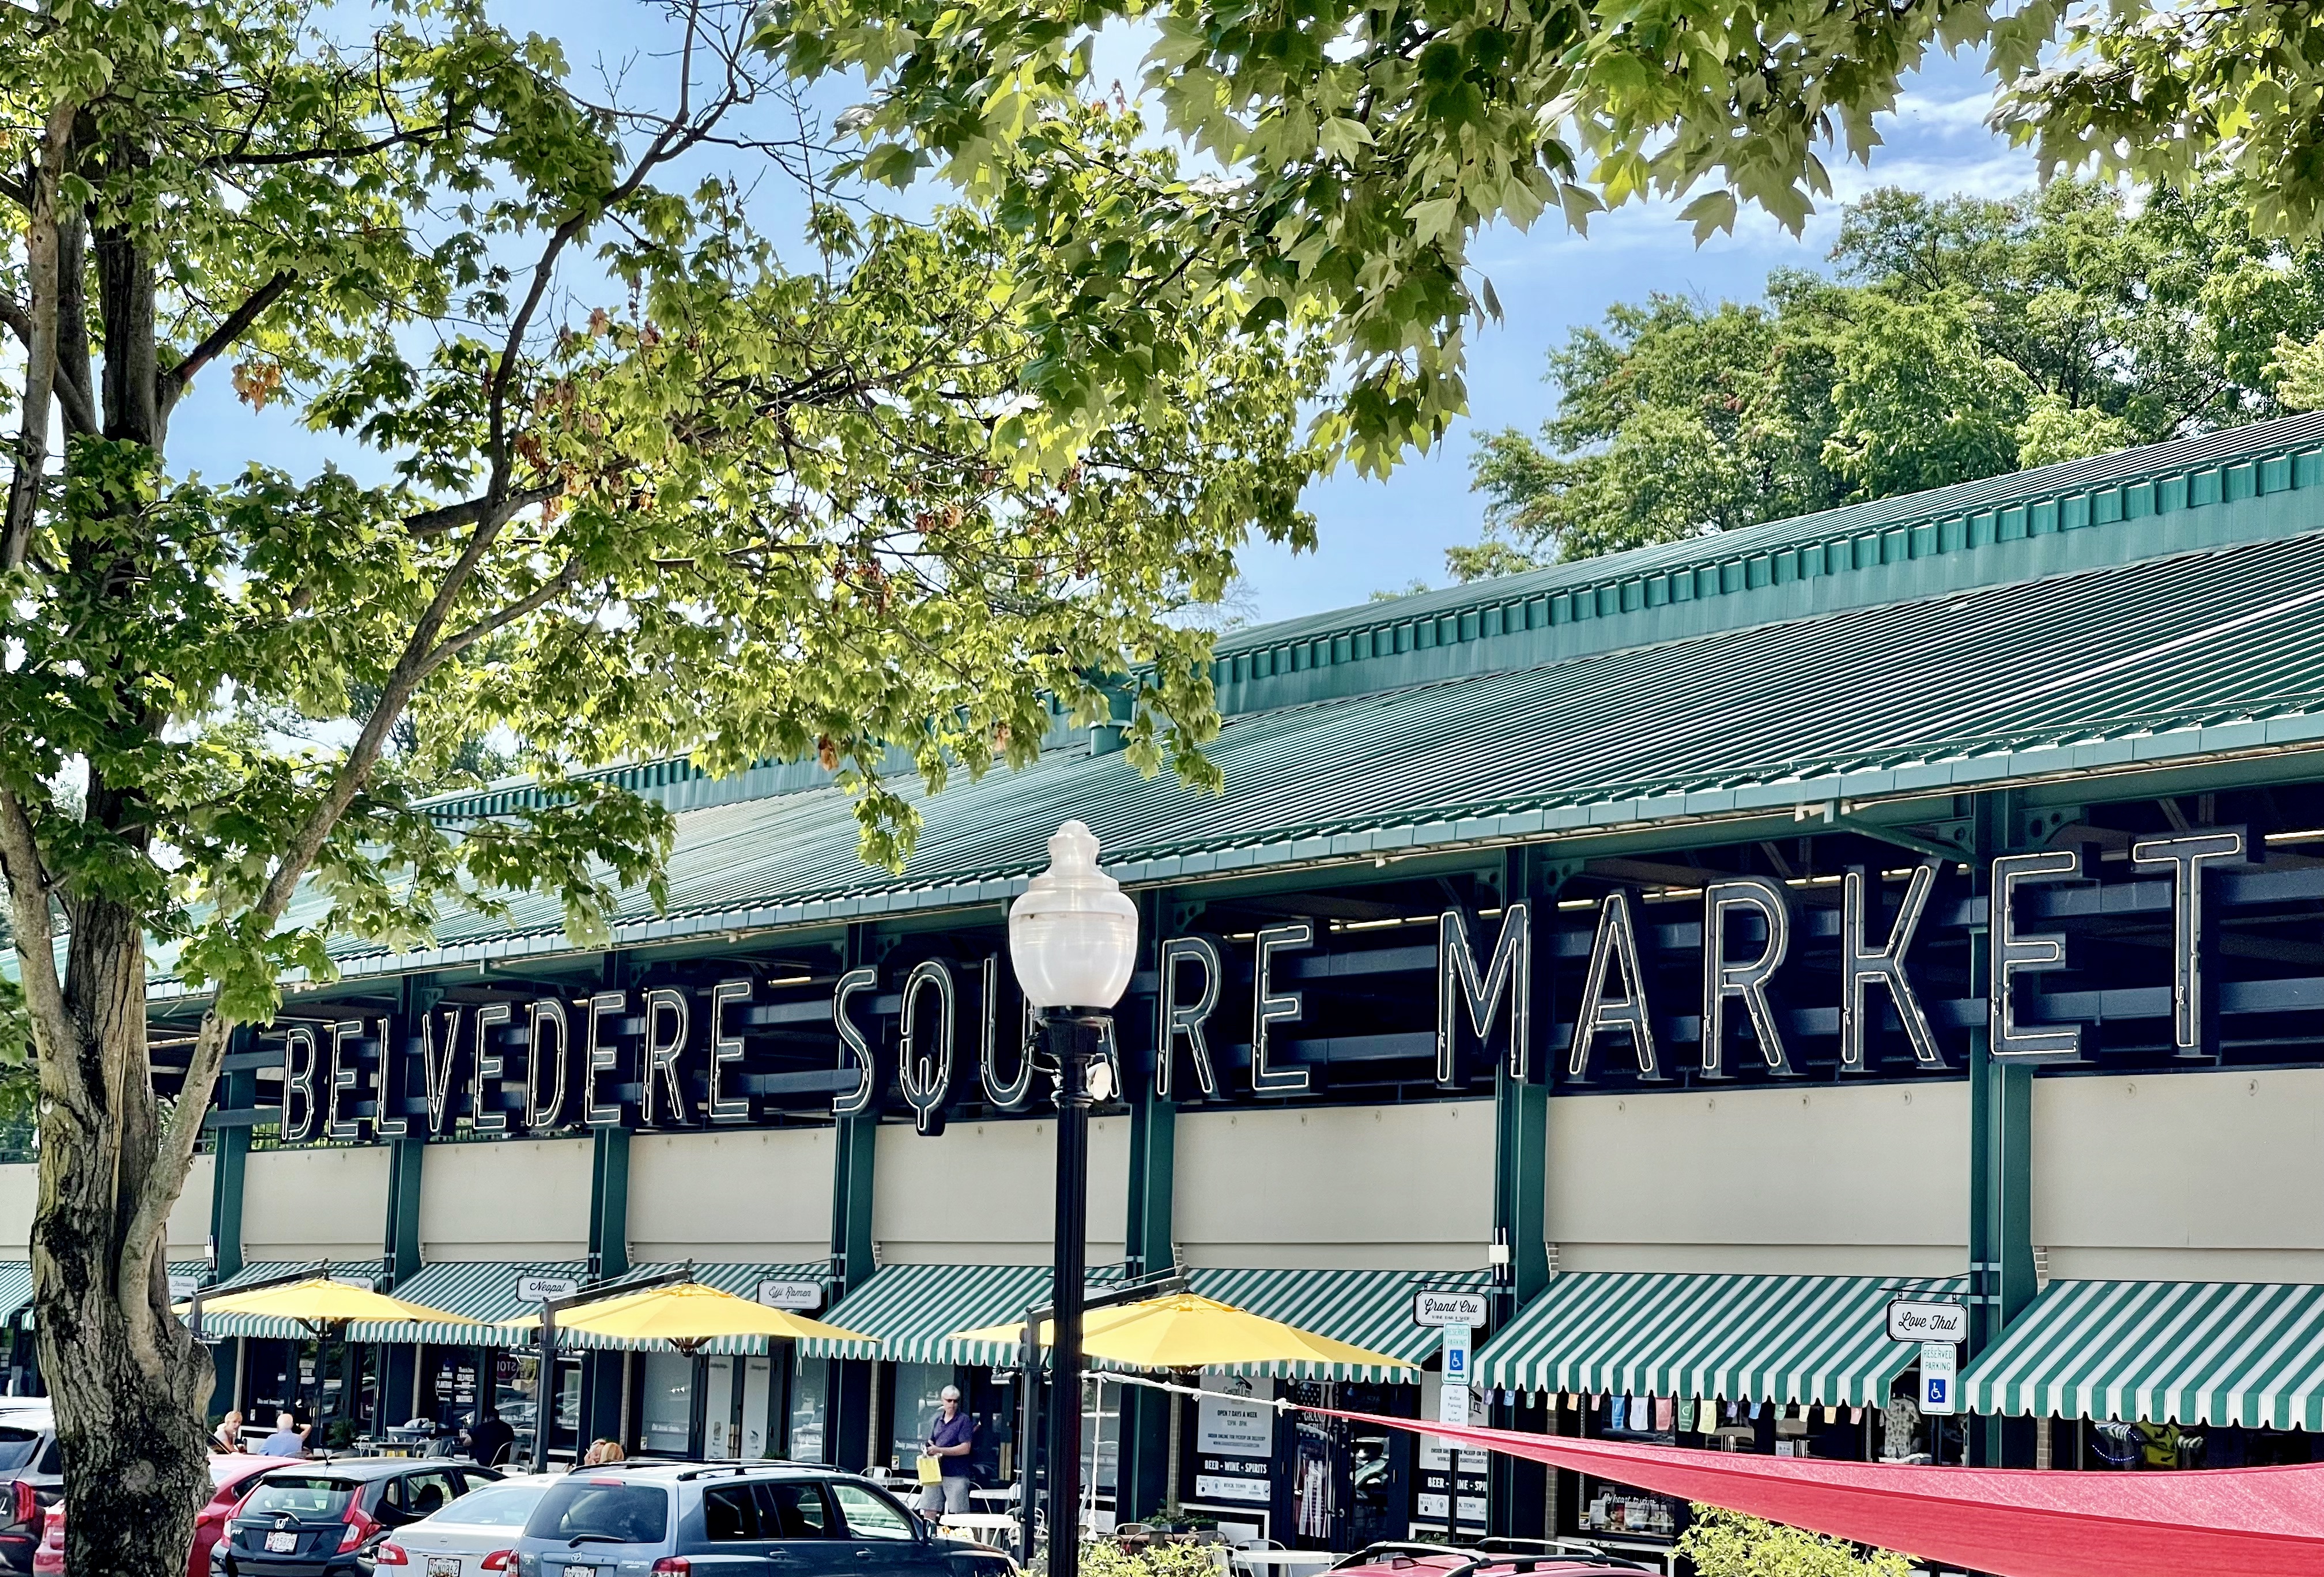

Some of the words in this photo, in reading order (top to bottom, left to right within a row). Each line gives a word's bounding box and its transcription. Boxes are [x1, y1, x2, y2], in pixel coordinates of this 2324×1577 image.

[281, 977, 753, 1144] BELVEDERE
[1435, 823, 2246, 1088] MARKET
[1424, 1298, 1458, 1315] Grand
[1459, 1300, 1478, 1313] Cru
[1898, 1311, 1927, 1331] Love
[1930, 1315, 1957, 1330] That
[1446, 1328, 1468, 1336] RESERVED
[1923, 1349, 1953, 1359] RESERVED
[1925, 1361, 1950, 1371] PARKING
[1304, 1411, 1326, 1423] GRAND
[1205, 1460, 1219, 1470] BEER
[1224, 1461, 1240, 1472] WINE
[1245, 1462, 1267, 1474] SPIRITS
[1428, 1477, 1444, 1488] BEER
[1457, 1479, 1469, 1489] INE
[1613, 1494, 1631, 1504] heart
